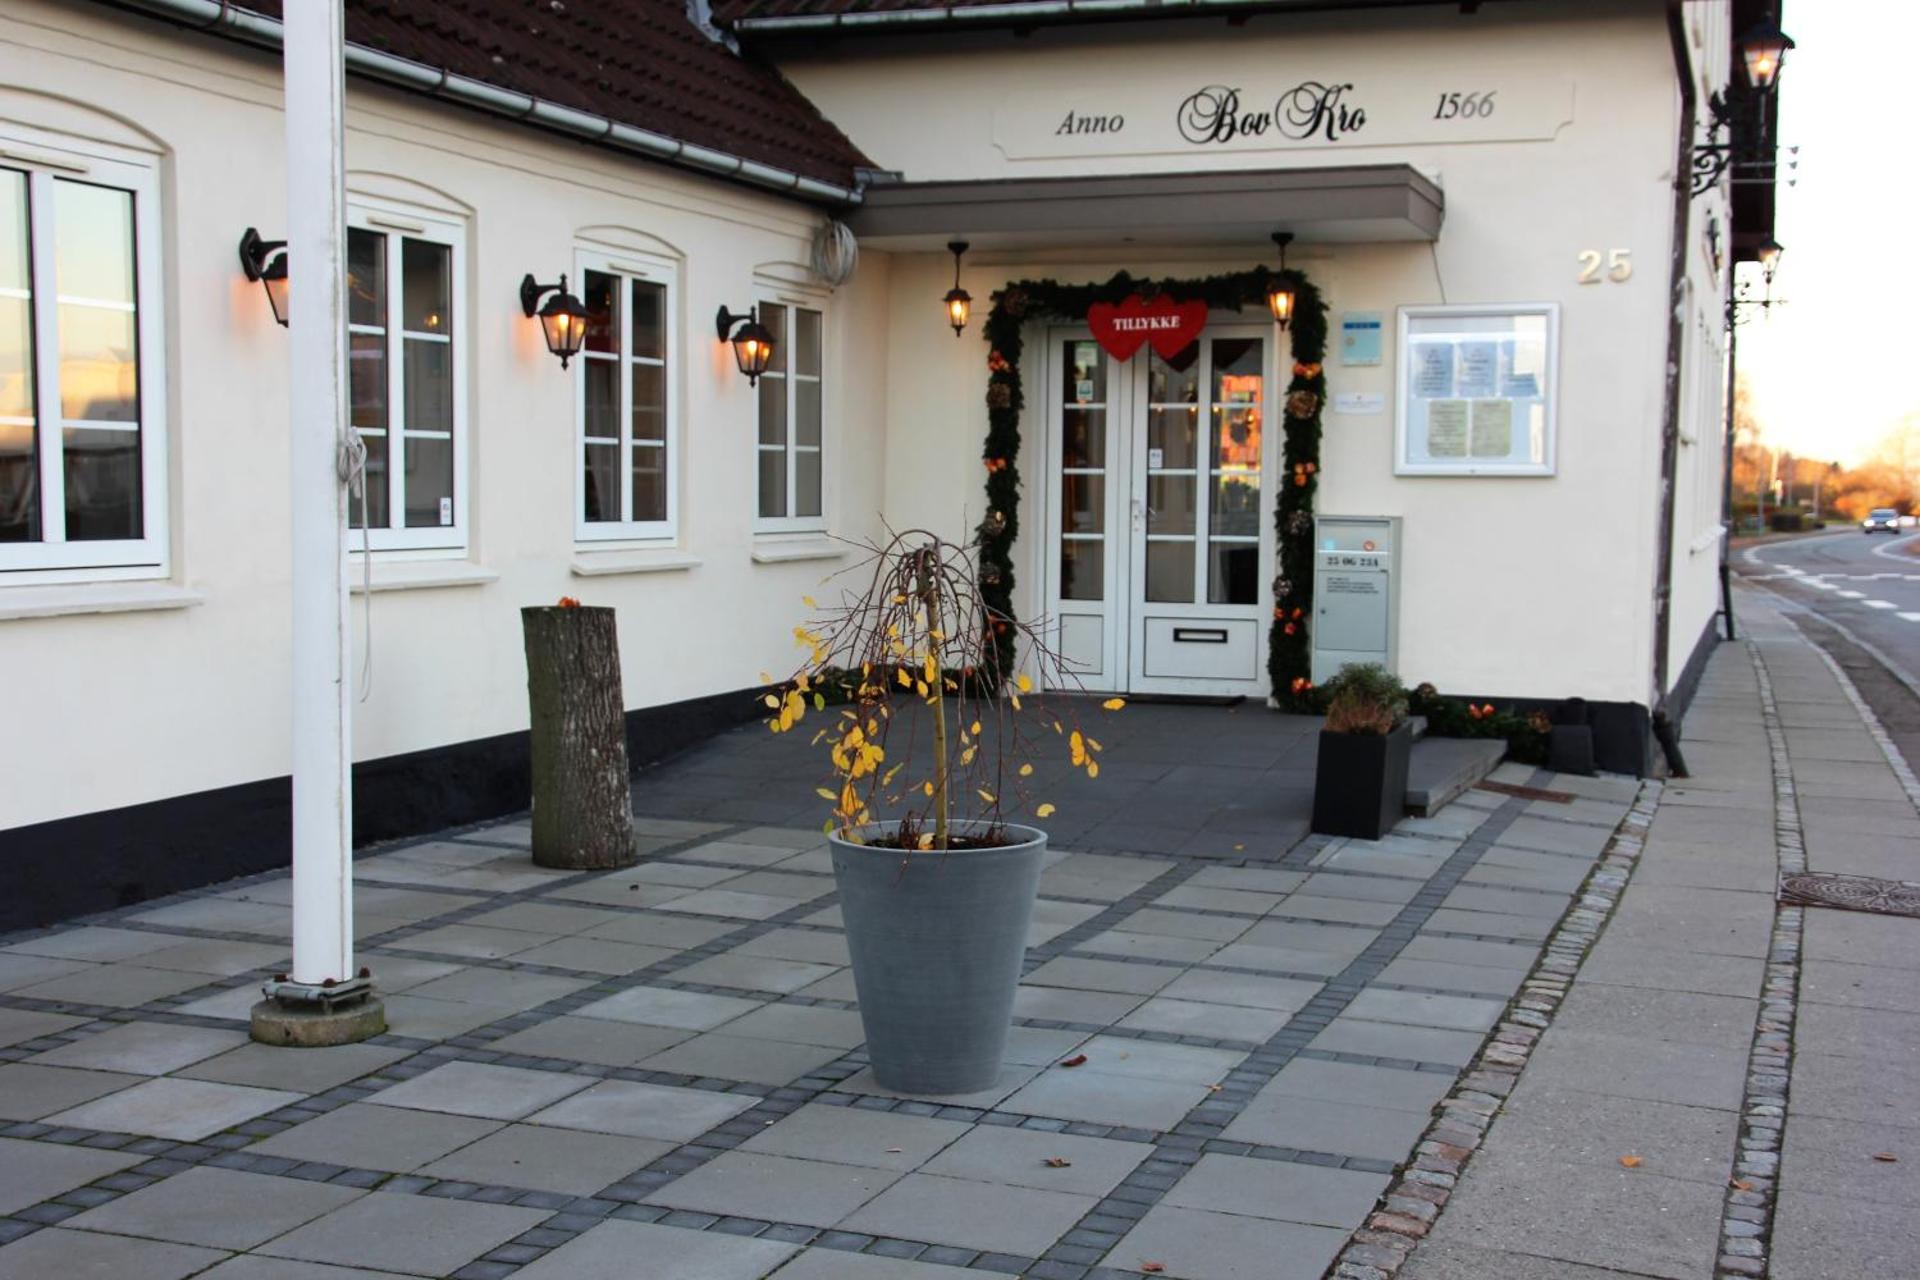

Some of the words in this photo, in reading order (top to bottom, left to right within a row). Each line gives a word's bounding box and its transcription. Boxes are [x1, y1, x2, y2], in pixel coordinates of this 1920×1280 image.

[1055, 109, 1124, 136] Anno
[1176, 84, 1271, 144] Bov
[1275, 81, 1366, 142] Kro
[1433, 90, 1498, 119] 1566
[1576, 248, 1633, 285] 25
[1112, 315, 1180, 331] TILLYKKE
